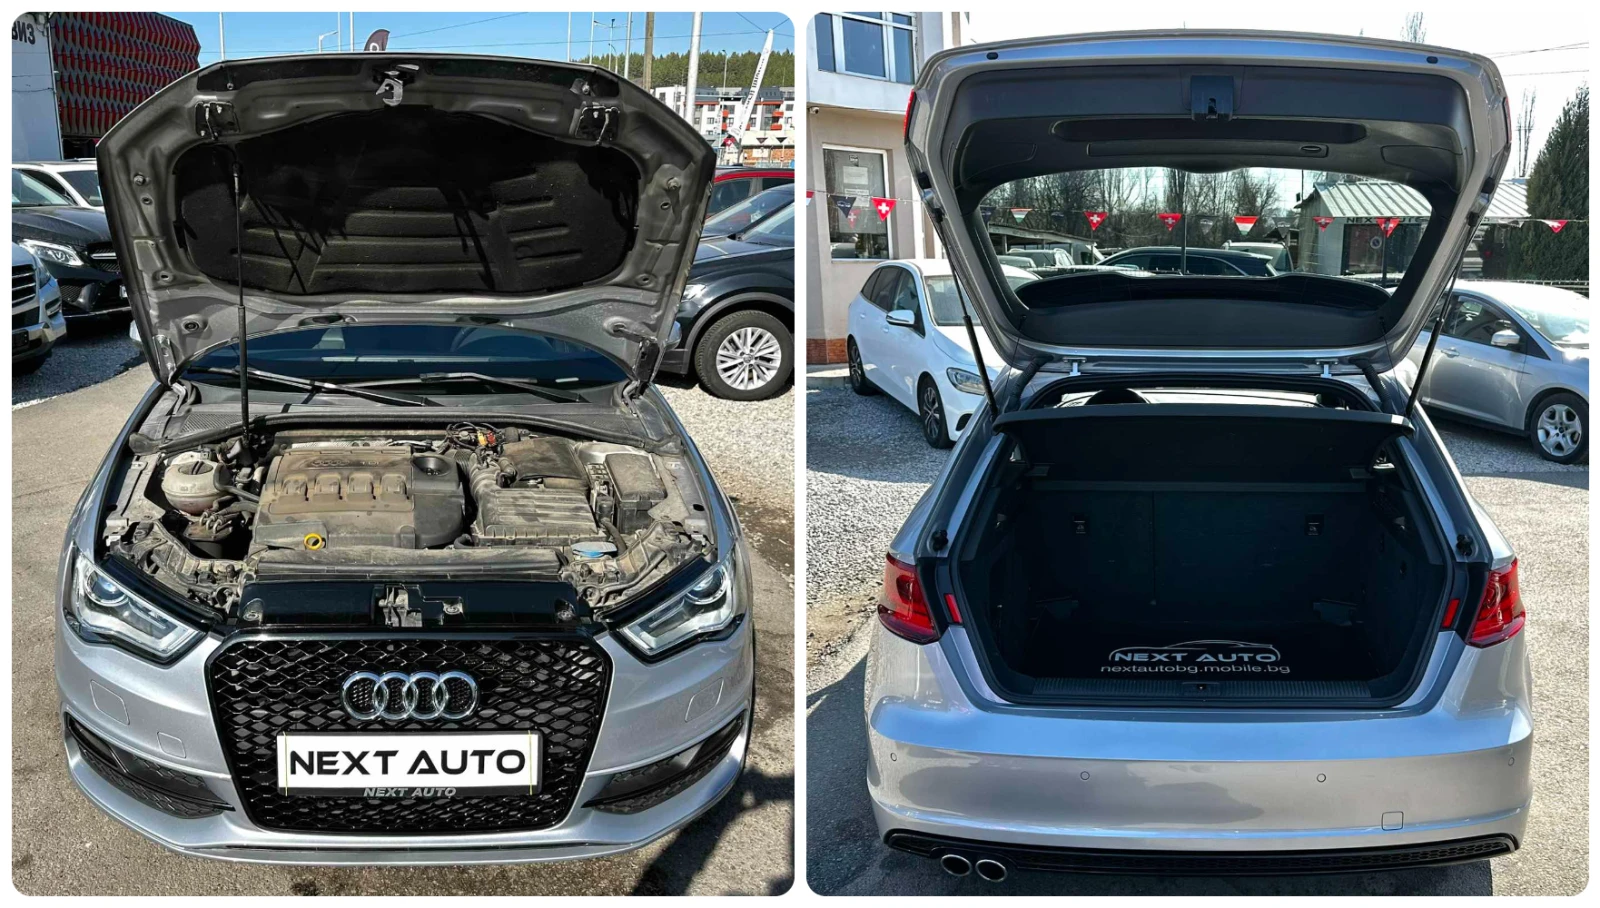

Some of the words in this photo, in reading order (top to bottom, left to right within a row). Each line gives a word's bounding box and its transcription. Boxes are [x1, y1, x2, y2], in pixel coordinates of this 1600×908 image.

[1114, 652, 1188, 662] NEXT
[1195, 652, 1276, 662] AUTO
[1100, 664, 1290, 674] nextautobg.mobile.bg
[290, 749, 399, 776] NEXT
[407, 749, 526, 775] AUTO
[363, 786, 408, 797] NEXT
[410, 786, 456, 797] AUTO
